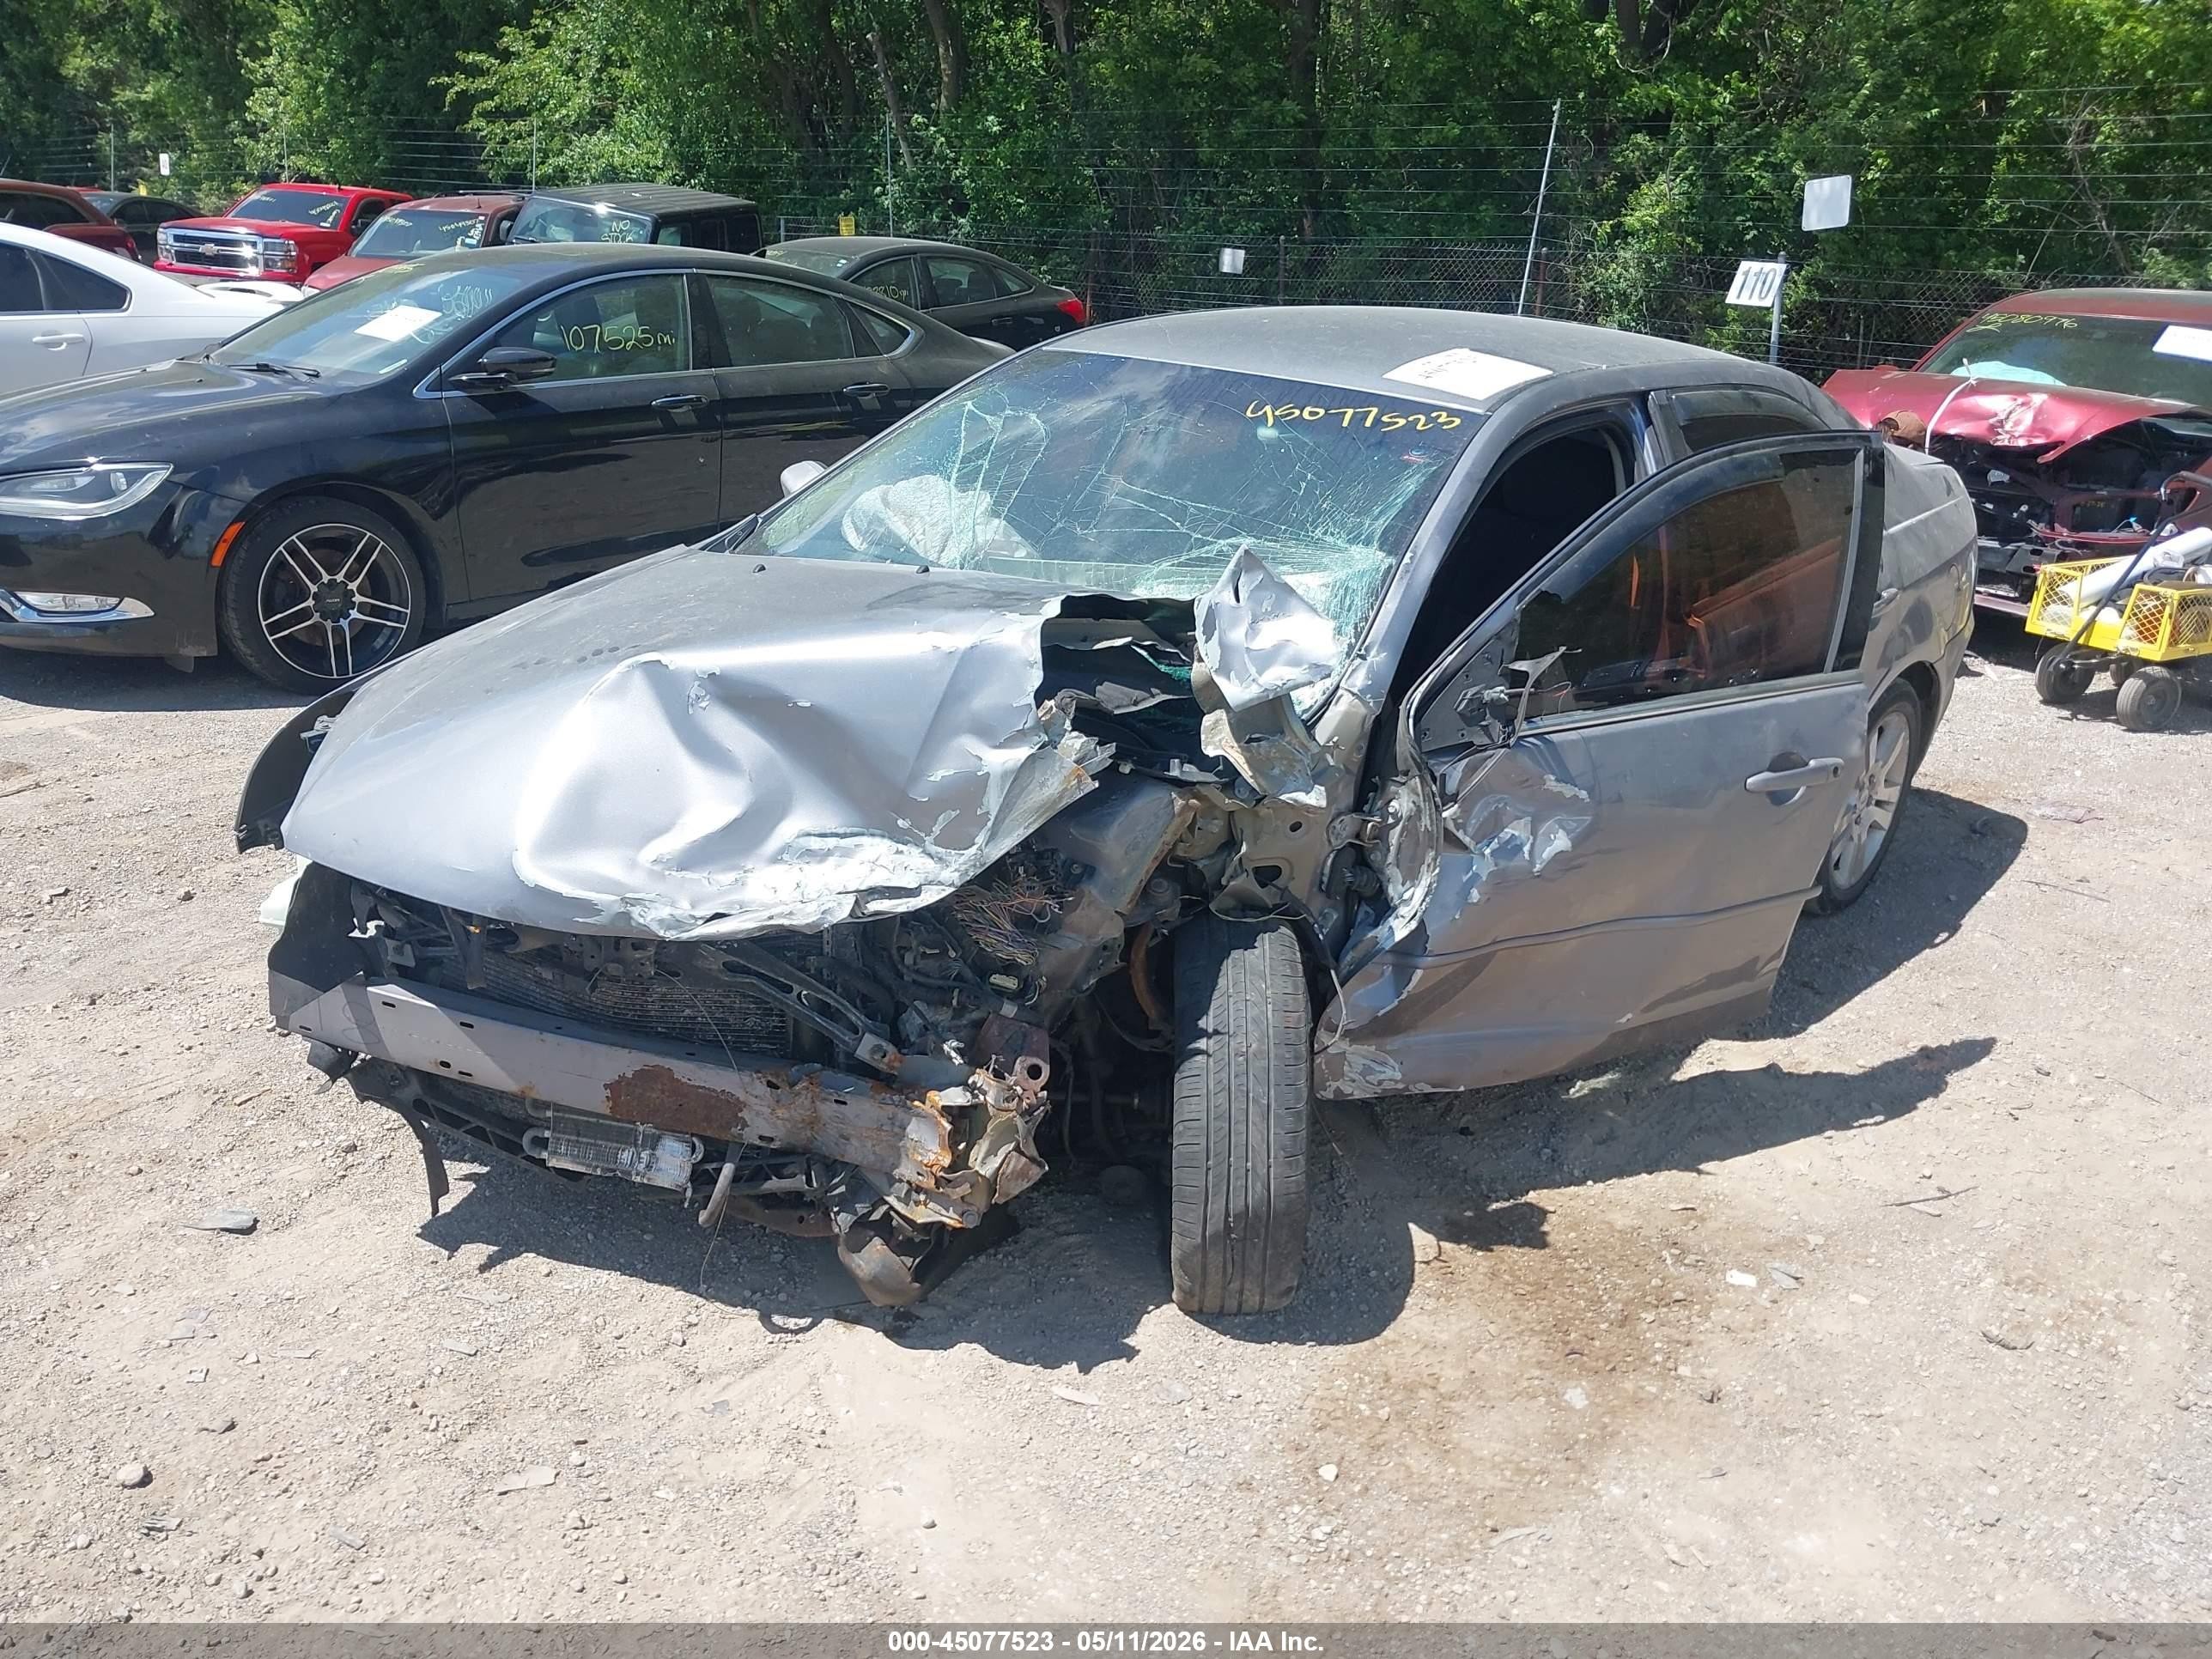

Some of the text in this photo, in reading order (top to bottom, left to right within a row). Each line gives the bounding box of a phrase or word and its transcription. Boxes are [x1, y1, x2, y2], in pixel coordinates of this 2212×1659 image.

[612, 220, 630, 232] NO
[1736, 266, 1778, 301] 110
[1246, 400, 1462, 432] 45077523
